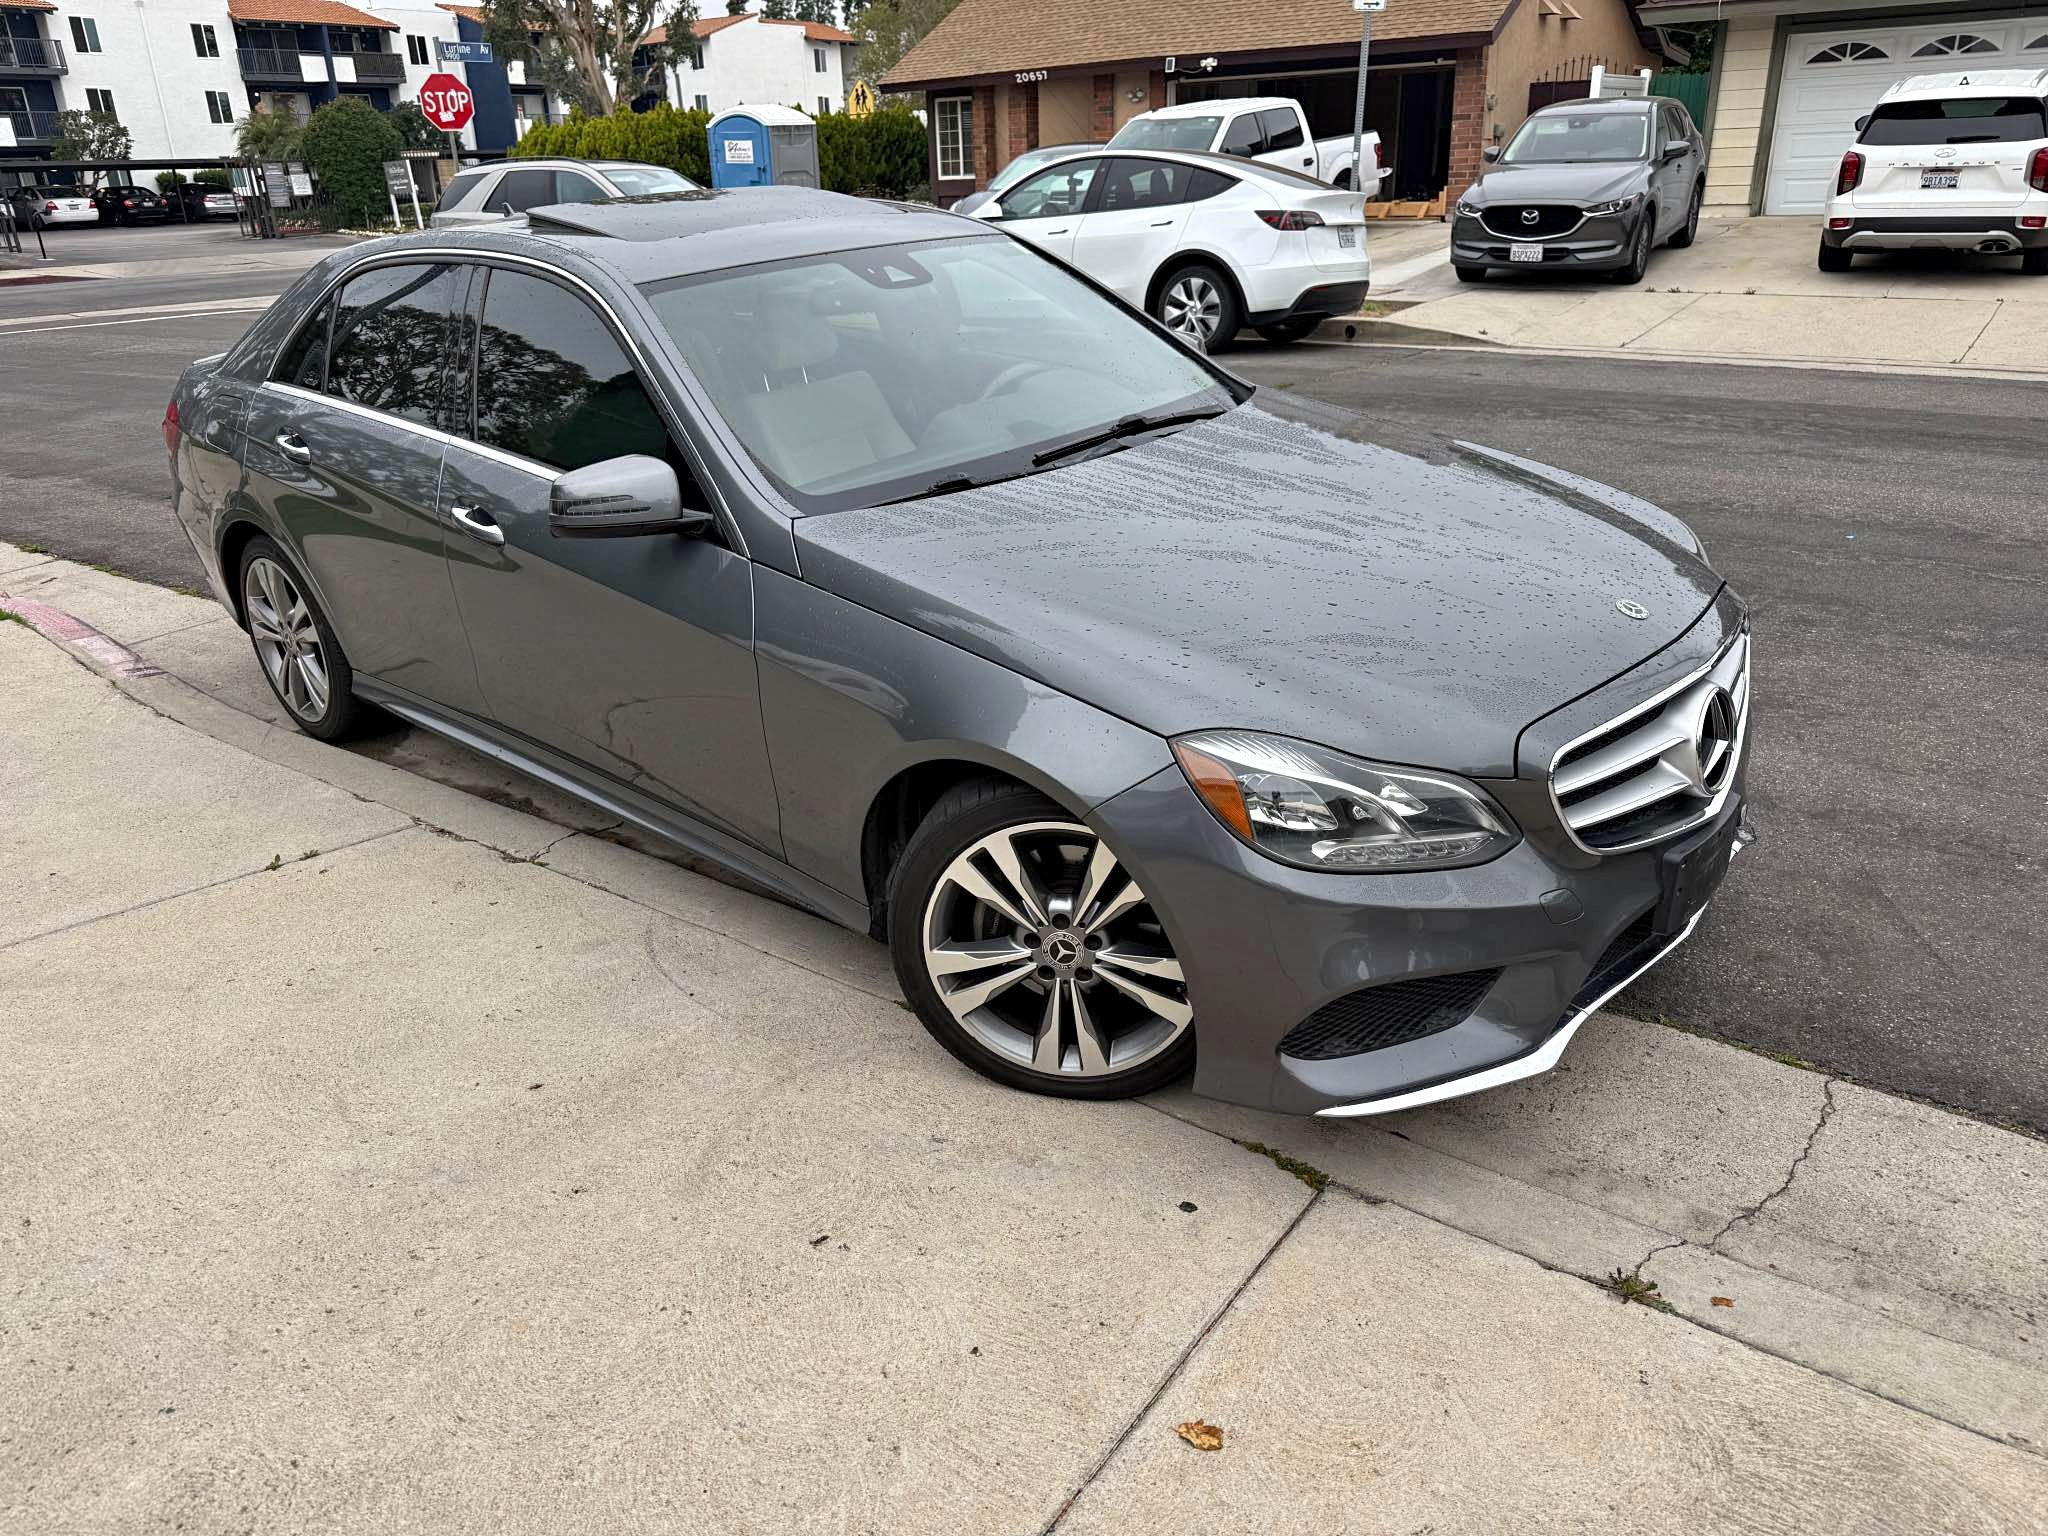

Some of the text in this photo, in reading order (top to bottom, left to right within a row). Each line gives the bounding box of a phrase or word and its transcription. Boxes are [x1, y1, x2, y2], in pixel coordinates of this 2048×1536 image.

[443, 43, 489, 54] Lurline Av
[1015, 70, 1048, 83] 20657
[424, 91, 469, 112] STOP
